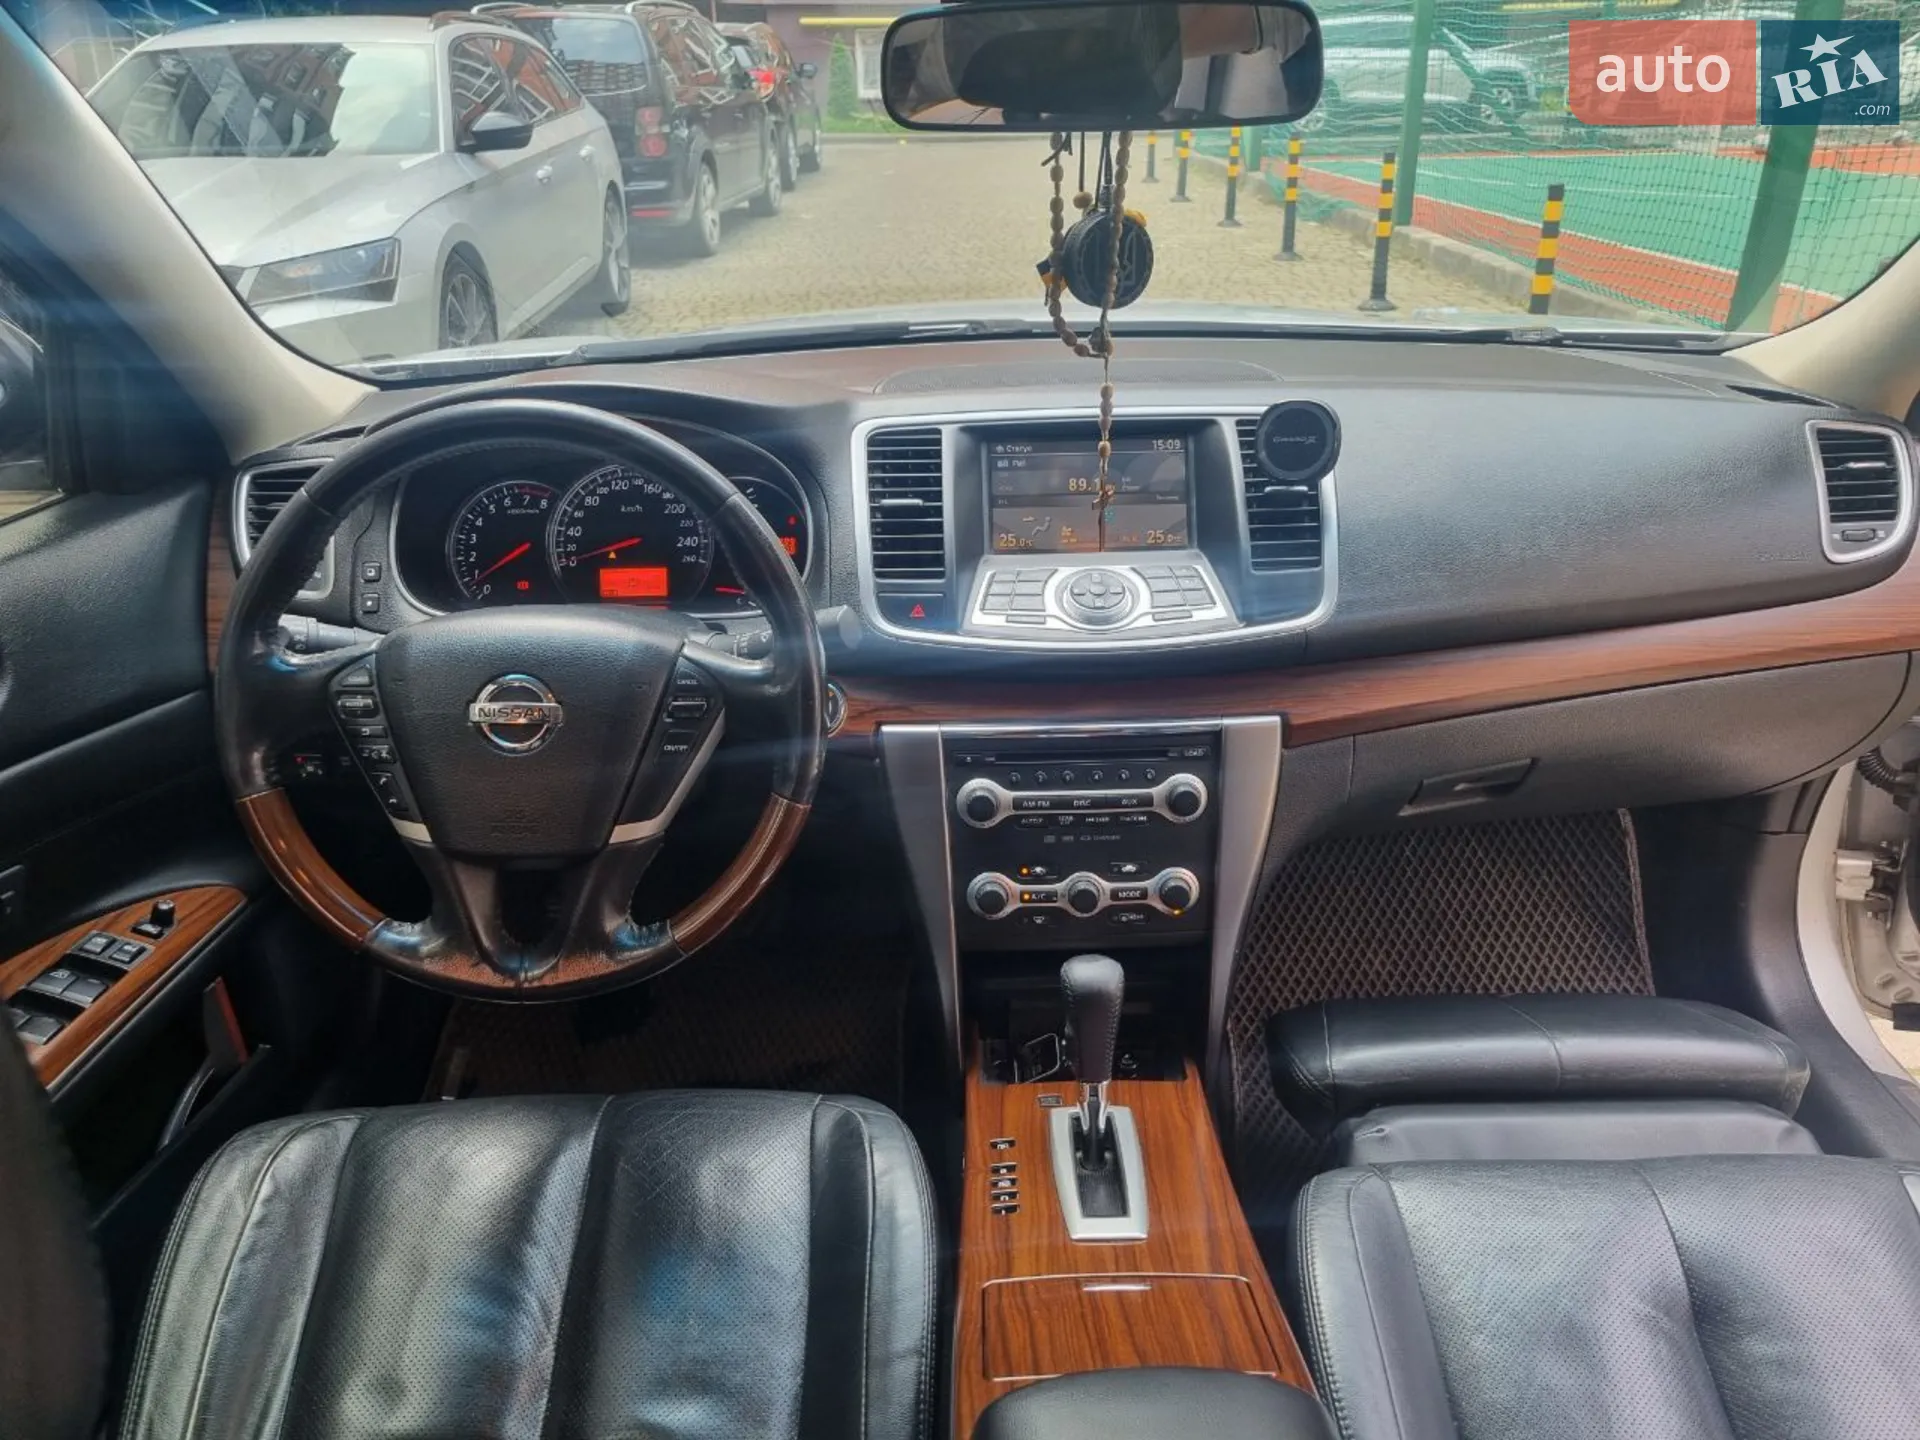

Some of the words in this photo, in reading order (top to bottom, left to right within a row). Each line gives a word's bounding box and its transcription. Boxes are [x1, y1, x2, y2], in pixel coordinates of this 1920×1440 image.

[611, 480, 629, 490] 120
[644, 483, 663, 494] 160
[503, 497, 512, 507] 6
[523, 494, 531, 506] 7
[540, 499, 548, 509] 8
[584, 496, 600, 507] 80
[488, 503, 497, 514] 5
[573, 510, 585, 518] 60
[663, 503, 686, 514] 200
[475, 517, 483, 527] 4
[566, 525, 583, 537] 40
[469, 533, 477, 544] 3
[676, 536, 699, 547] 240
[566, 543, 577, 552] 20
[469, 551, 477, 562] 2
[483, 584, 492, 594] 0
[478, 707, 551, 718] NISSAN
